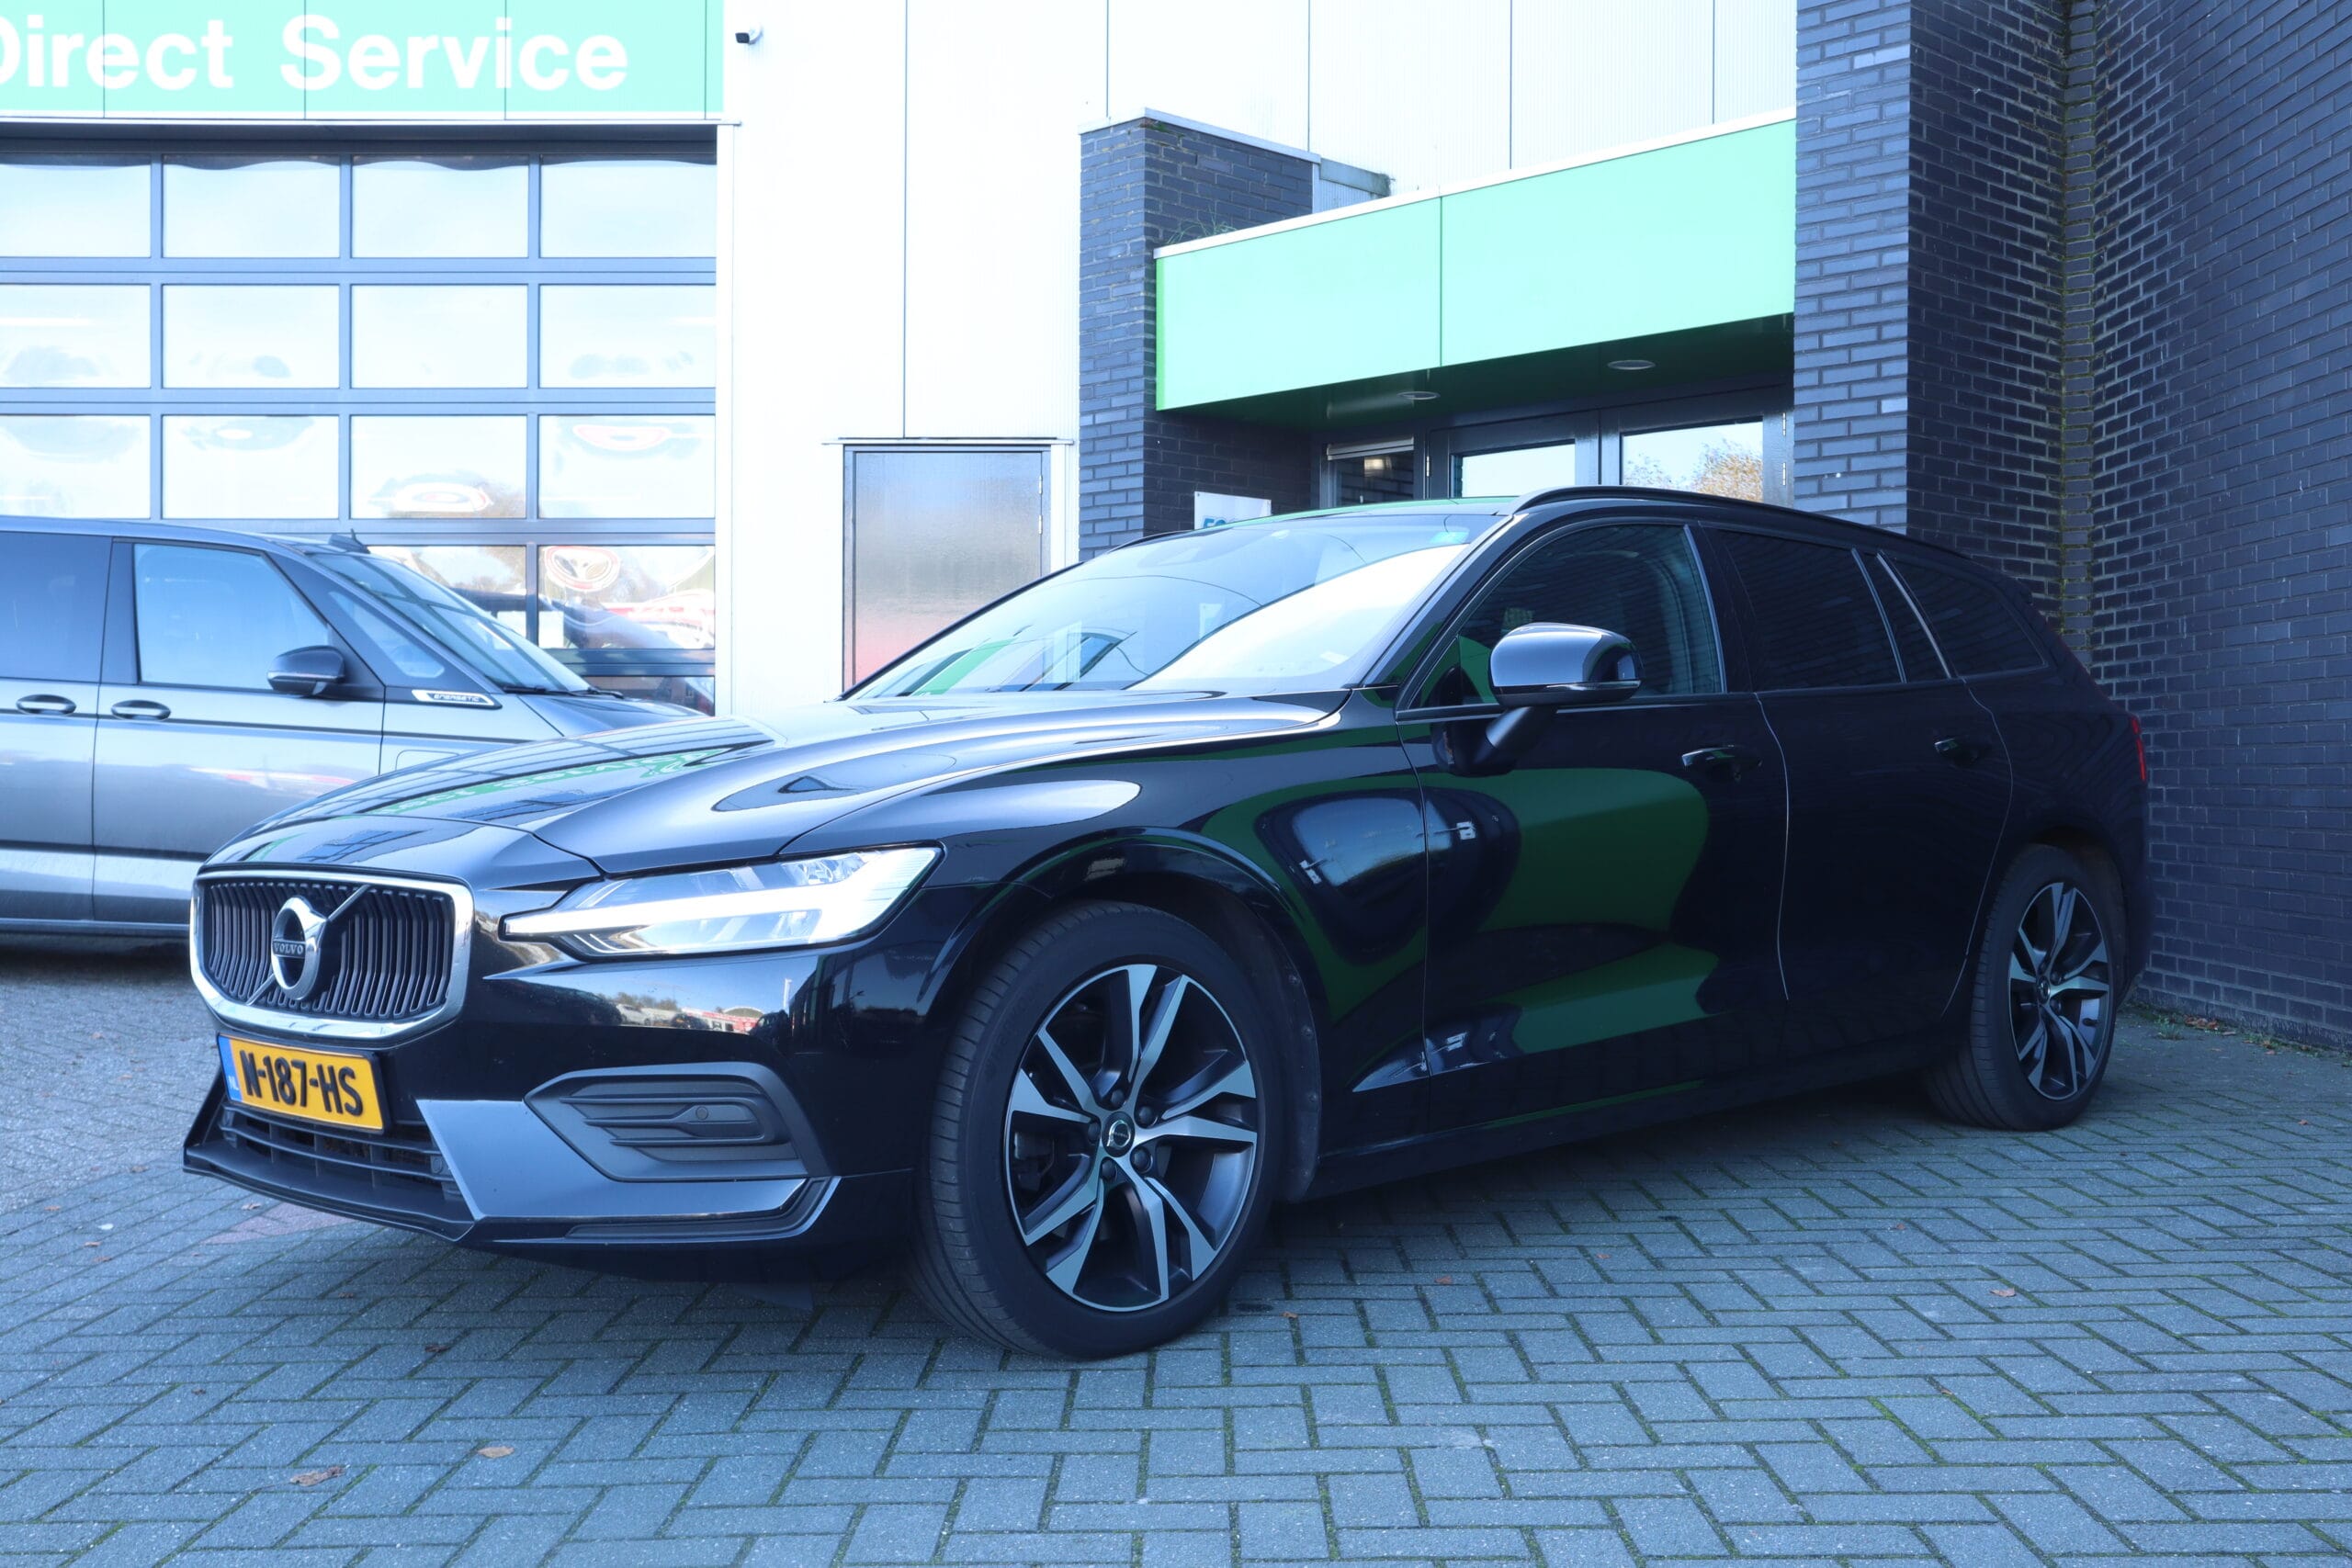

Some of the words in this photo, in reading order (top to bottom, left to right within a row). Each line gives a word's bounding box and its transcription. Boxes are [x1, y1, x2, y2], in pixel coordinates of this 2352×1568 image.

[280, 14, 628, 91] Service
[274, 942, 304, 955] VOLVO
[240, 1050, 364, 1117] N-187-HS
